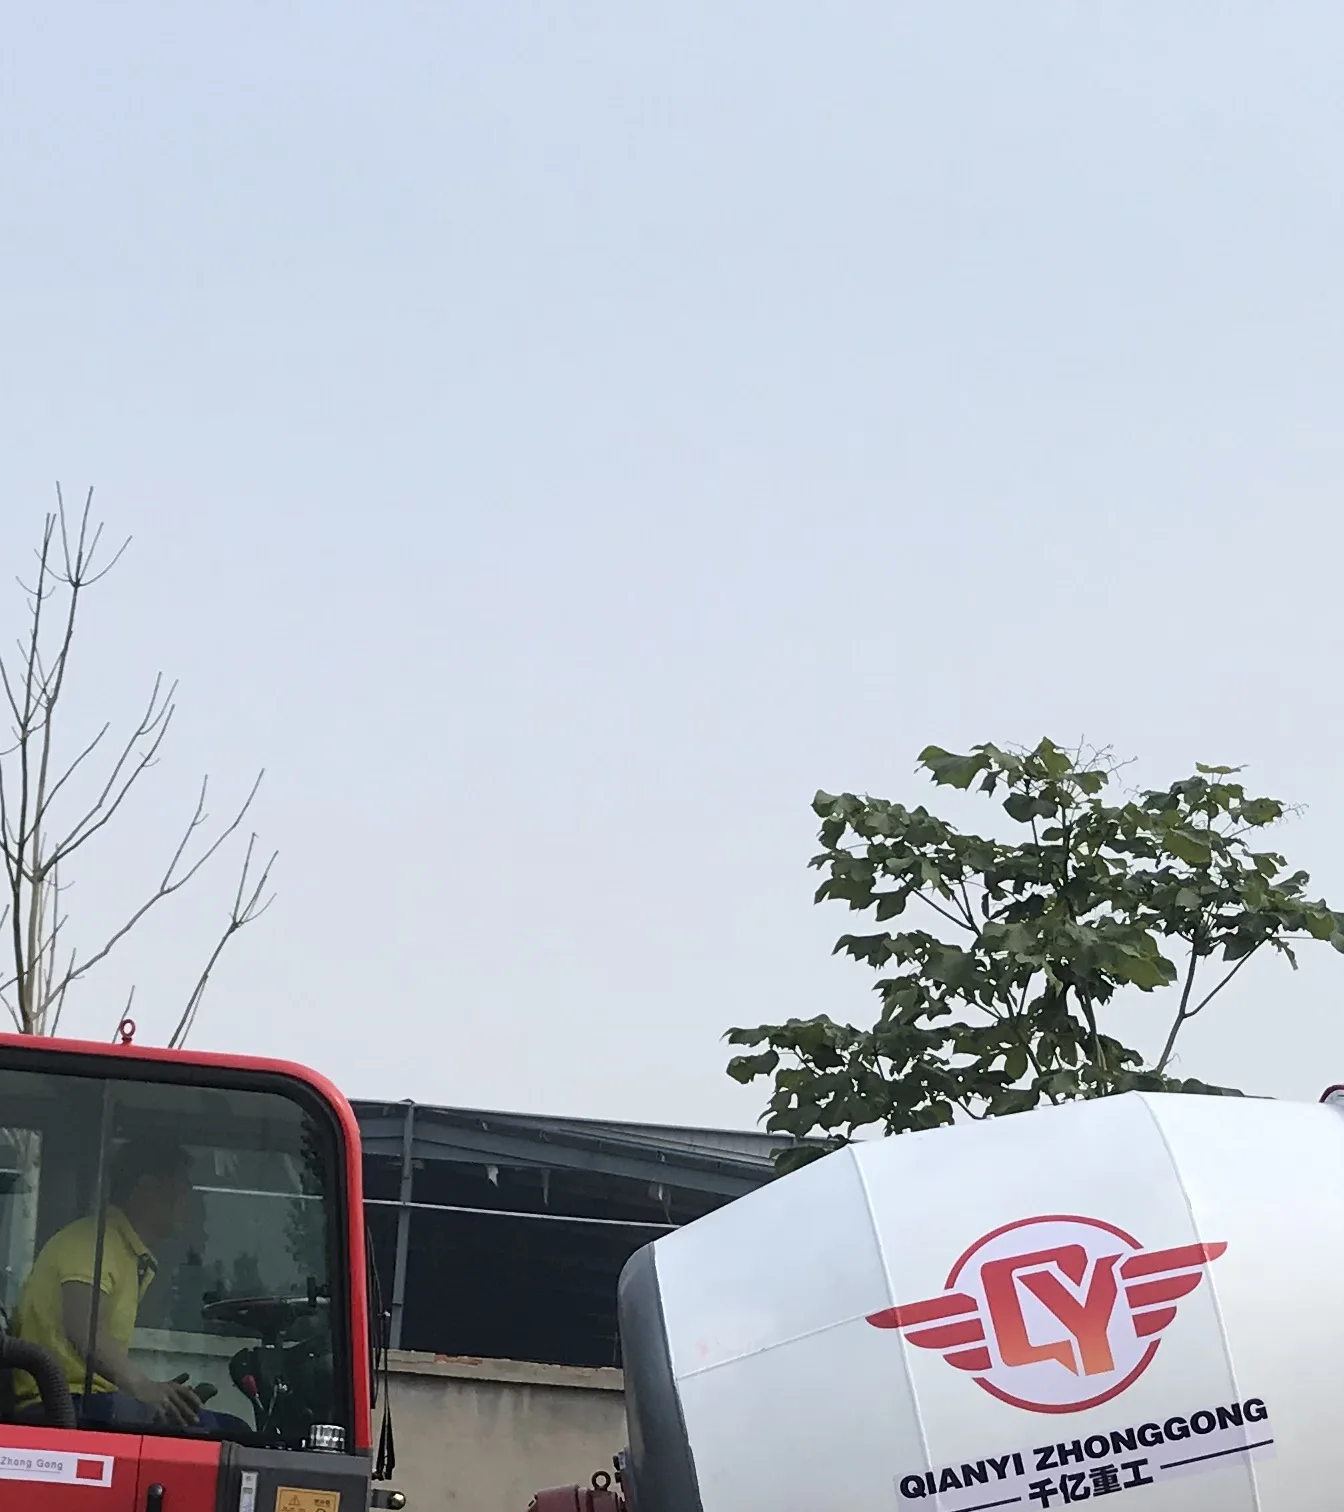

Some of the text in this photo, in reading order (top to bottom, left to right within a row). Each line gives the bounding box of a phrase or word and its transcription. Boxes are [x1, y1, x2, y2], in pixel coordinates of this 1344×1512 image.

[0, 1456, 32, 1468] Zhong
[36, 1458, 64, 1471] Gong
[899, 1397, 1269, 1499] QIANYI ZHONGGONG
[1028, 1457, 1154, 1509] 千亿重工
